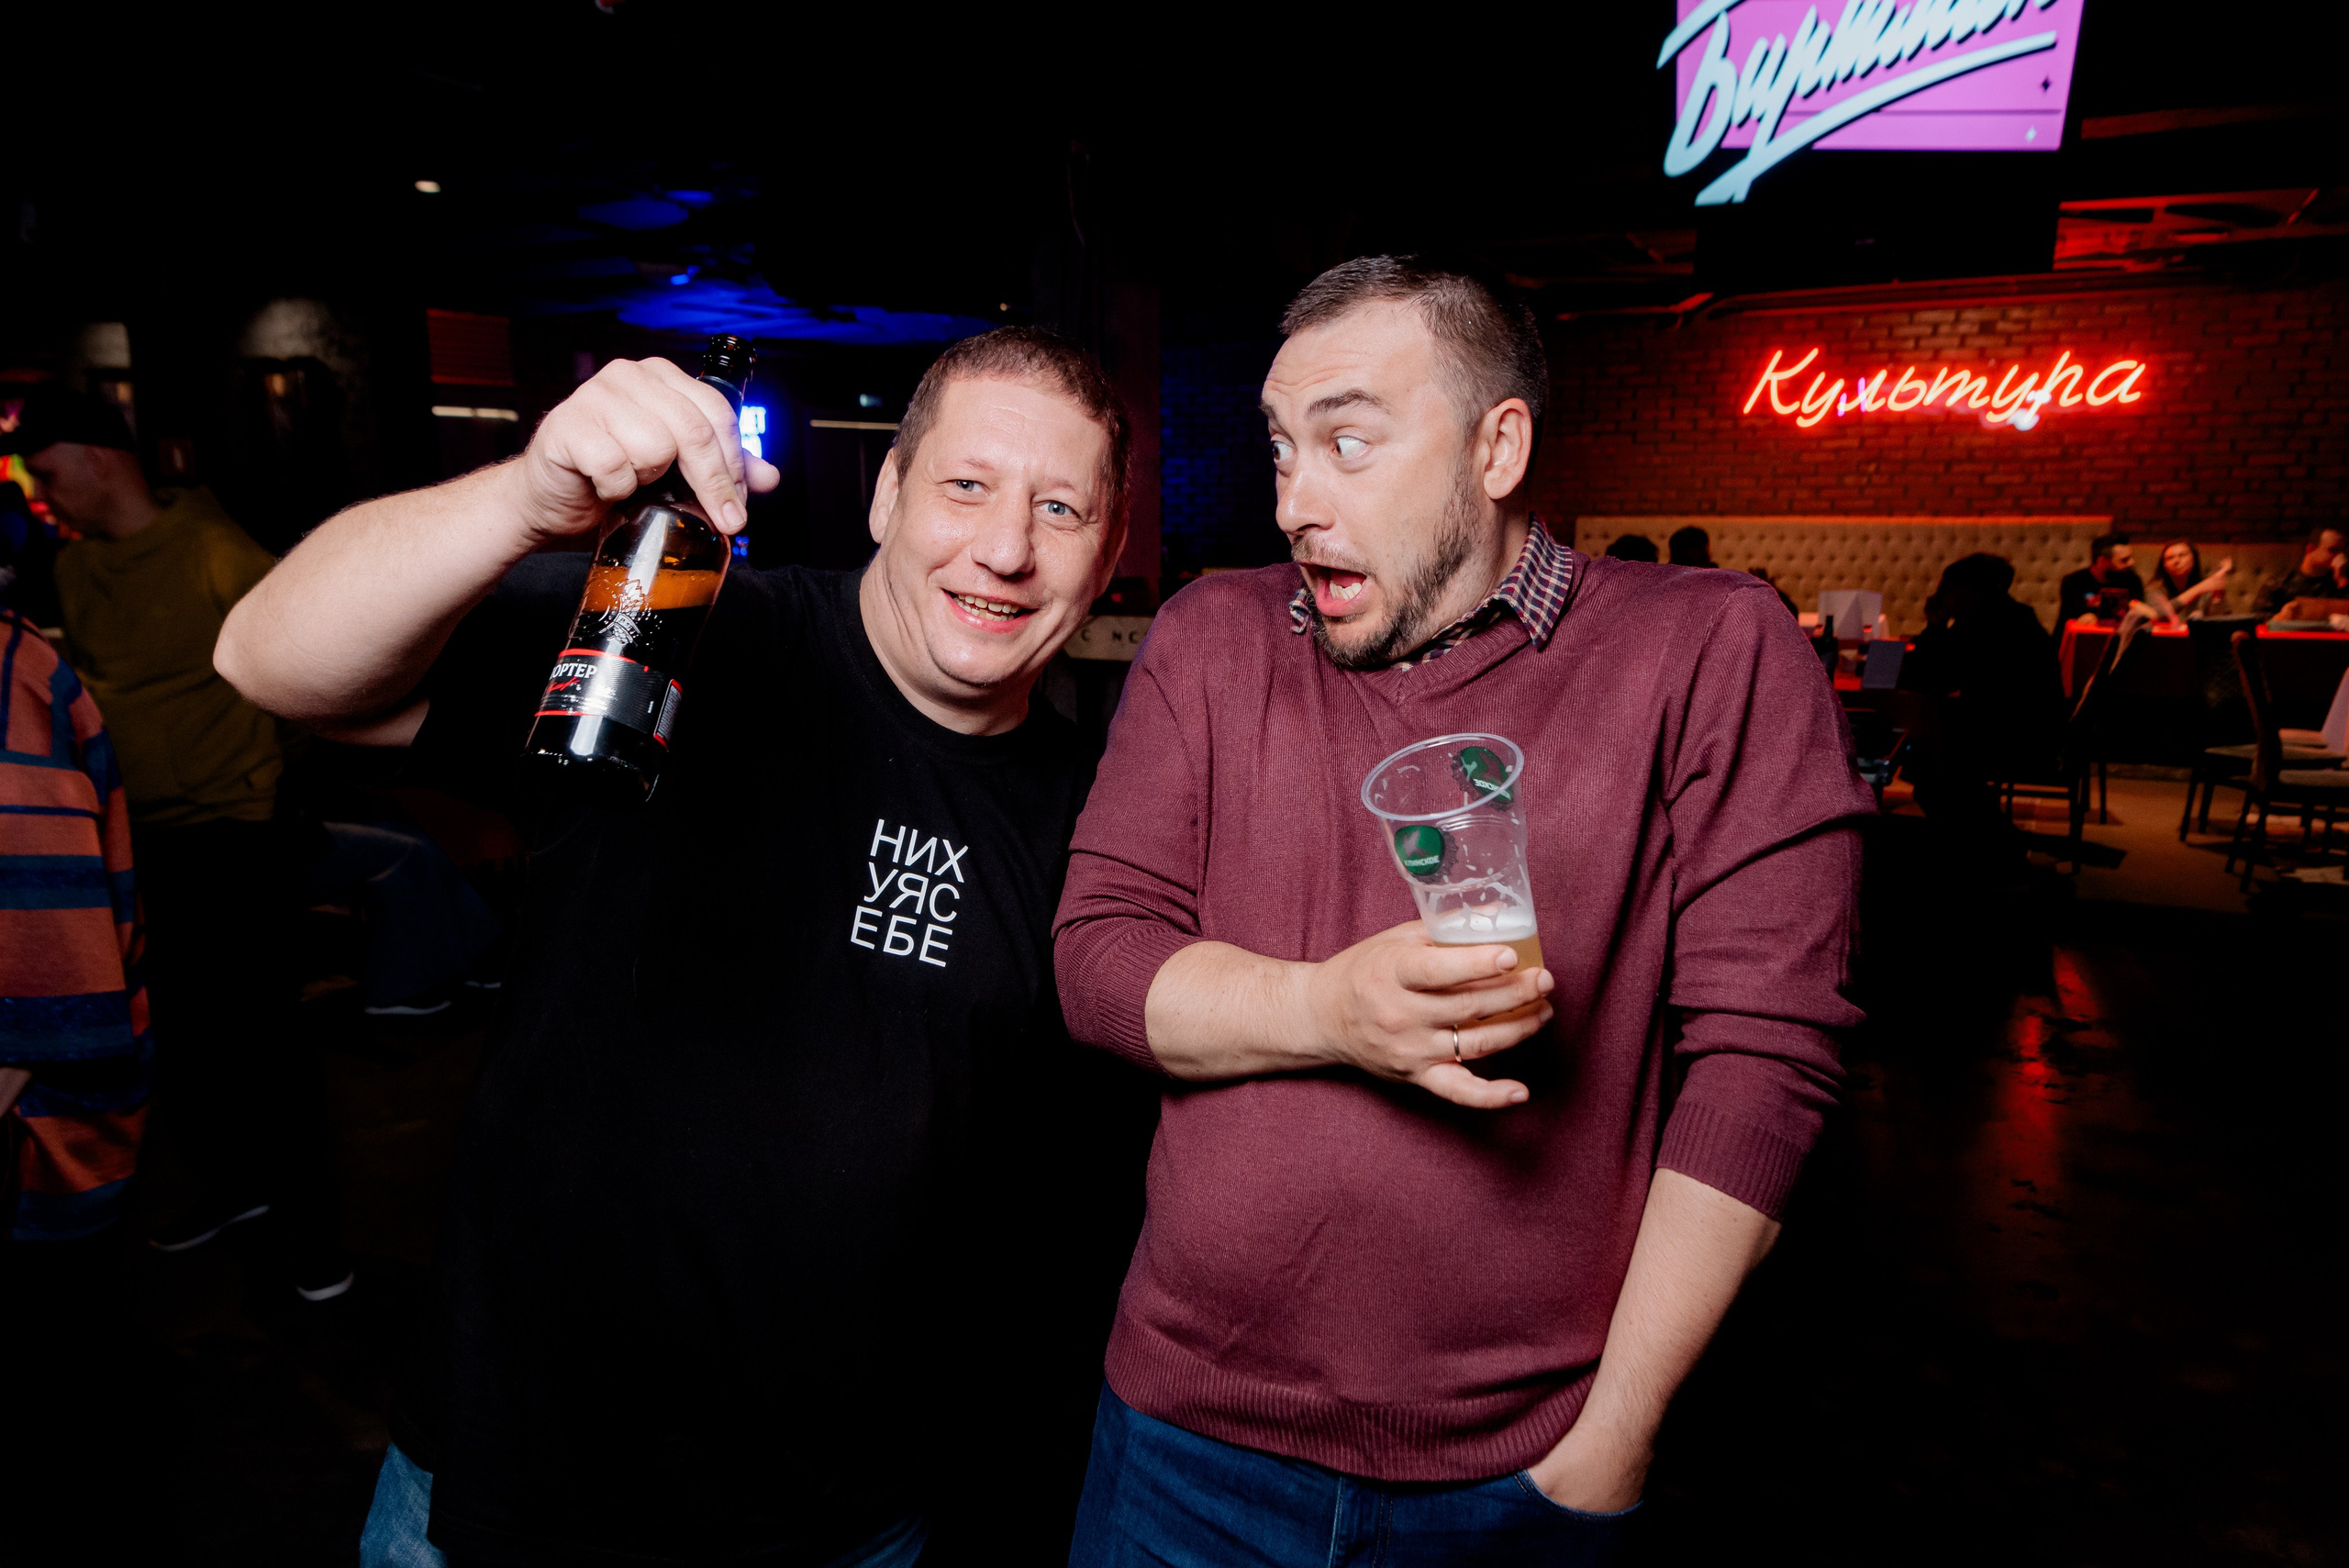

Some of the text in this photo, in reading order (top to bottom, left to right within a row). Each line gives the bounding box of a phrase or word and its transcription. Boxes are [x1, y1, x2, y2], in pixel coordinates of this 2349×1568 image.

[1742, 347, 2146, 428] Культура
[550, 662, 598, 681] ОРТЕР
[870, 818, 969, 884] НИХ
[863, 862, 960, 922] УЯС
[850, 906, 953, 968] ЕБЕ
